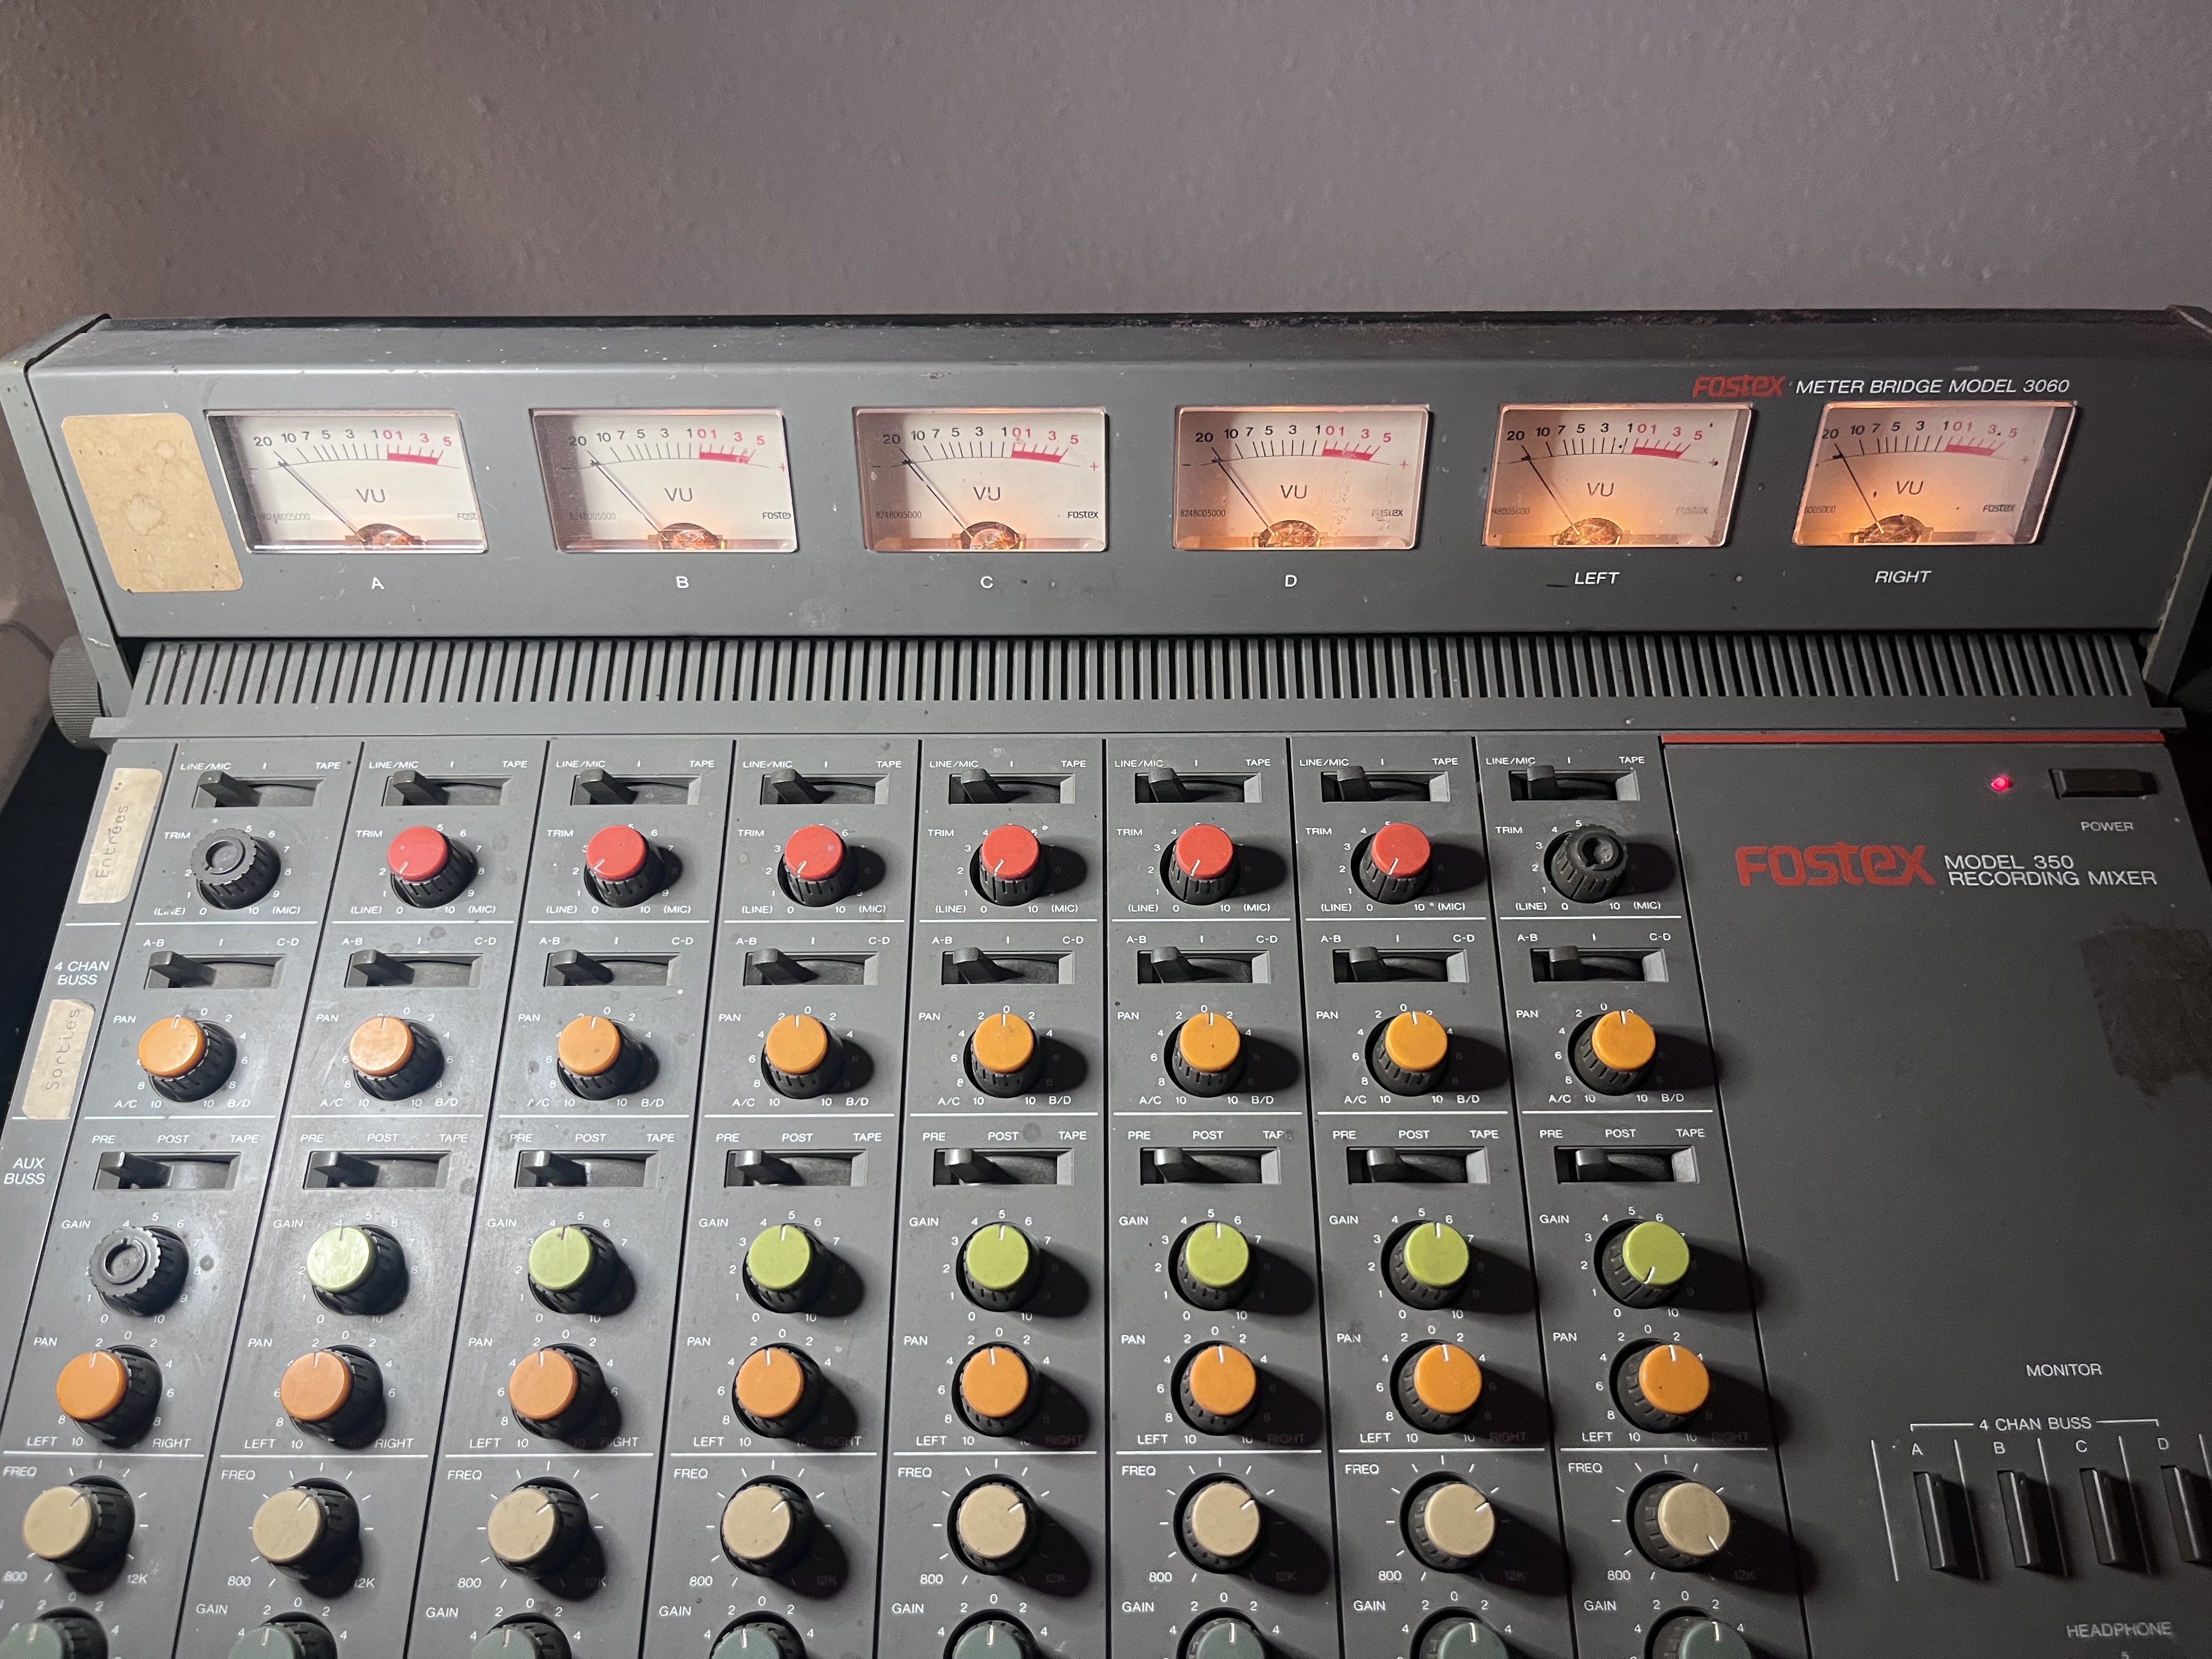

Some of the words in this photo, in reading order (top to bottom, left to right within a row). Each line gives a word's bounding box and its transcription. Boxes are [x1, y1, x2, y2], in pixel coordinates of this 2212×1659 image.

[1796, 380, 1865, 394] METER
[1869, 380, 1943, 393] BRIDGE
[1948, 379, 2017, 393] MODEL
[2023, 379, 2070, 393] 3060
[882, 434, 901, 444] 20
[910, 431, 926, 441] 10
[932, 428, 940, 439] 7
[951, 427, 960, 437] 5
[975, 426, 984, 437] 3
[1001, 426, 1007, 437] 1
[1012, 427, 1022, 438] 0
[1026, 427, 1031, 438] 1
[1048, 430, 1057, 441] 3
[1070, 434, 1079, 445] 5
[1280, 484, 1307, 499] VU
[1587, 482, 1615, 497] VU
[1896, 480, 1924, 495] VU
[356, 488, 386, 503] VU
[664, 488, 693, 502] VU
[973, 487, 1001, 501] VU
[1285, 574, 1297, 587] D
[1575, 572, 1621, 585] LEFT
[1875, 570, 1932, 583] RIGHT
[371, 577, 385, 590] A
[676, 575, 689, 589] B
[980, 575, 994, 589] C
[180, 762, 232, 770] LINE/MIC
[315, 761, 341, 770] TAPE
[369, 761, 419, 769] LINE/MIC
[743, 760, 793, 769] LINE/MIC
[1115, 759, 1163, 768] LINE/MIC
[1245, 758, 1271, 766] TAPE
[1299, 758, 1349, 766] LINE/MIC
[1432, 757, 1459, 765] TAPE
[2080, 821, 2134, 832] POWER
[356, 830, 383, 838] TRIM
[1944, 854, 2025, 870] MODEL
[2033, 855, 2074, 869] 350
[1948, 871, 2080, 886] RECORDING
[2087, 871, 2158, 885] MIXER
[272, 906, 301, 915] (MIC)
[351, 905, 382, 915] (LINE)
[663, 905, 691, 914] (MIC)
[742, 905, 773, 914] (LINE)
[1051, 904, 1078, 913] (MIC)
[1128, 904, 1159, 913] (LINE)
[1437, 902, 1465, 911] (MIC)
[1515, 901, 1547, 911] (LINE)
[475, 936, 496, 945] C-D
[539, 936, 560, 945] A-B
[868, 936, 890, 945] C-D
[932, 936, 952, 944] A-B
[1256, 935, 1278, 944] C-D
[1321, 934, 1341, 943] A-B
[1649, 933, 1671, 941] C-D
[143, 939, 165, 947] A-B
[54, 962, 63, 971] 4
[67, 961, 110, 972] CHAN
[57, 974, 98, 985] BUSS
[113, 1015, 136, 1023] PAN
[518, 1013, 541, 1022] PAN
[918, 1012, 941, 1021] PAN
[1316, 1011, 1339, 1019] PAN
[45, 1008, 81, 1091] Sorties
[227, 1098, 251, 1108] B/D
[641, 1098, 664, 1107] B/D
[732, 1098, 755, 1107] A/C
[1049, 1096, 1071, 1105] B/D
[1139, 1096, 1162, 1105] A/C
[1457, 1094, 1480, 1104] B/D
[1548, 1094, 1571, 1103] A/C
[114, 1099, 138, 1109] A/C
[716, 1133, 740, 1142] PRE
[782, 1133, 814, 1142] POST
[923, 1132, 946, 1141] PRE
[988, 1131, 1019, 1141] POST
[1058, 1131, 1087, 1140] TAPE
[1333, 1130, 1357, 1139] PRE
[1398, 1130, 1430, 1139] POST
[1539, 1129, 1564, 1138] PRE
[1605, 1128, 1637, 1138] POST
[1675, 1128, 1706, 1137] TAPE
[92, 1135, 116, 1144] PRE
[157, 1135, 190, 1144] POST
[230, 1134, 259, 1143] TAPE
[439, 1133, 468, 1143] TAPE
[510, 1133, 533, 1143] PRE
[575, 1133, 607, 1143] POST
[13, 1157, 46, 1169] AUX
[3, 1173, 46, 1185] BUSS
[487, 1218, 517, 1228] GAIN
[698, 1218, 729, 1228] GAIN
[1119, 1216, 1148, 1226] GAIN
[1539, 1214, 1570, 1224] GAIN
[61, 1220, 91, 1229] GAIN
[33, 1337, 58, 1346] PAN
[687, 1336, 711, 1346] PAN
[1121, 1334, 1146, 1345] PAN
[1553, 1332, 1577, 1342] PAN
[2026, 1363, 2102, 1376] MONITOR
[1979, 1419, 1989, 1430] 4
[1995, 1418, 2042, 1431] CHAN
[2047, 1417, 2092, 1430] BUSS
[26, 1436, 58, 1446] LEFT
[916, 1435, 947, 1446] LEFT
[1360, 1432, 1391, 1443] LEFT
[1582, 1431, 1613, 1442] LEFT
[153, 1438, 191, 1448] RIGHT
[375, 1438, 414, 1449] RIGHT
[469, 1437, 502, 1448] LEFT
[1993, 1441, 2006, 1454] B
[2075, 1440, 2087, 1453] C
[2157, 1437, 2169, 1450] D
[1912, 1443, 1923, 1456] A
[898, 1467, 932, 1478] FREQ
[1345, 1464, 1379, 1475] FREQ
[1568, 1463, 1602, 1474] FREQ
[447, 1470, 482, 1480] FREQ
[128, 1573, 148, 1584] 12K
[1149, 1571, 1172, 1582] 800
[1607, 1570, 1631, 1581] 800
[227, 1576, 251, 1587] 800
[689, 1576, 713, 1587] 800
[196, 1603, 228, 1615] GAIN
[1353, 1600, 1386, 1611] GAIN
[659, 1605, 691, 1617] GAIN
[2066, 1621, 2172, 1638] HEADPHONE
